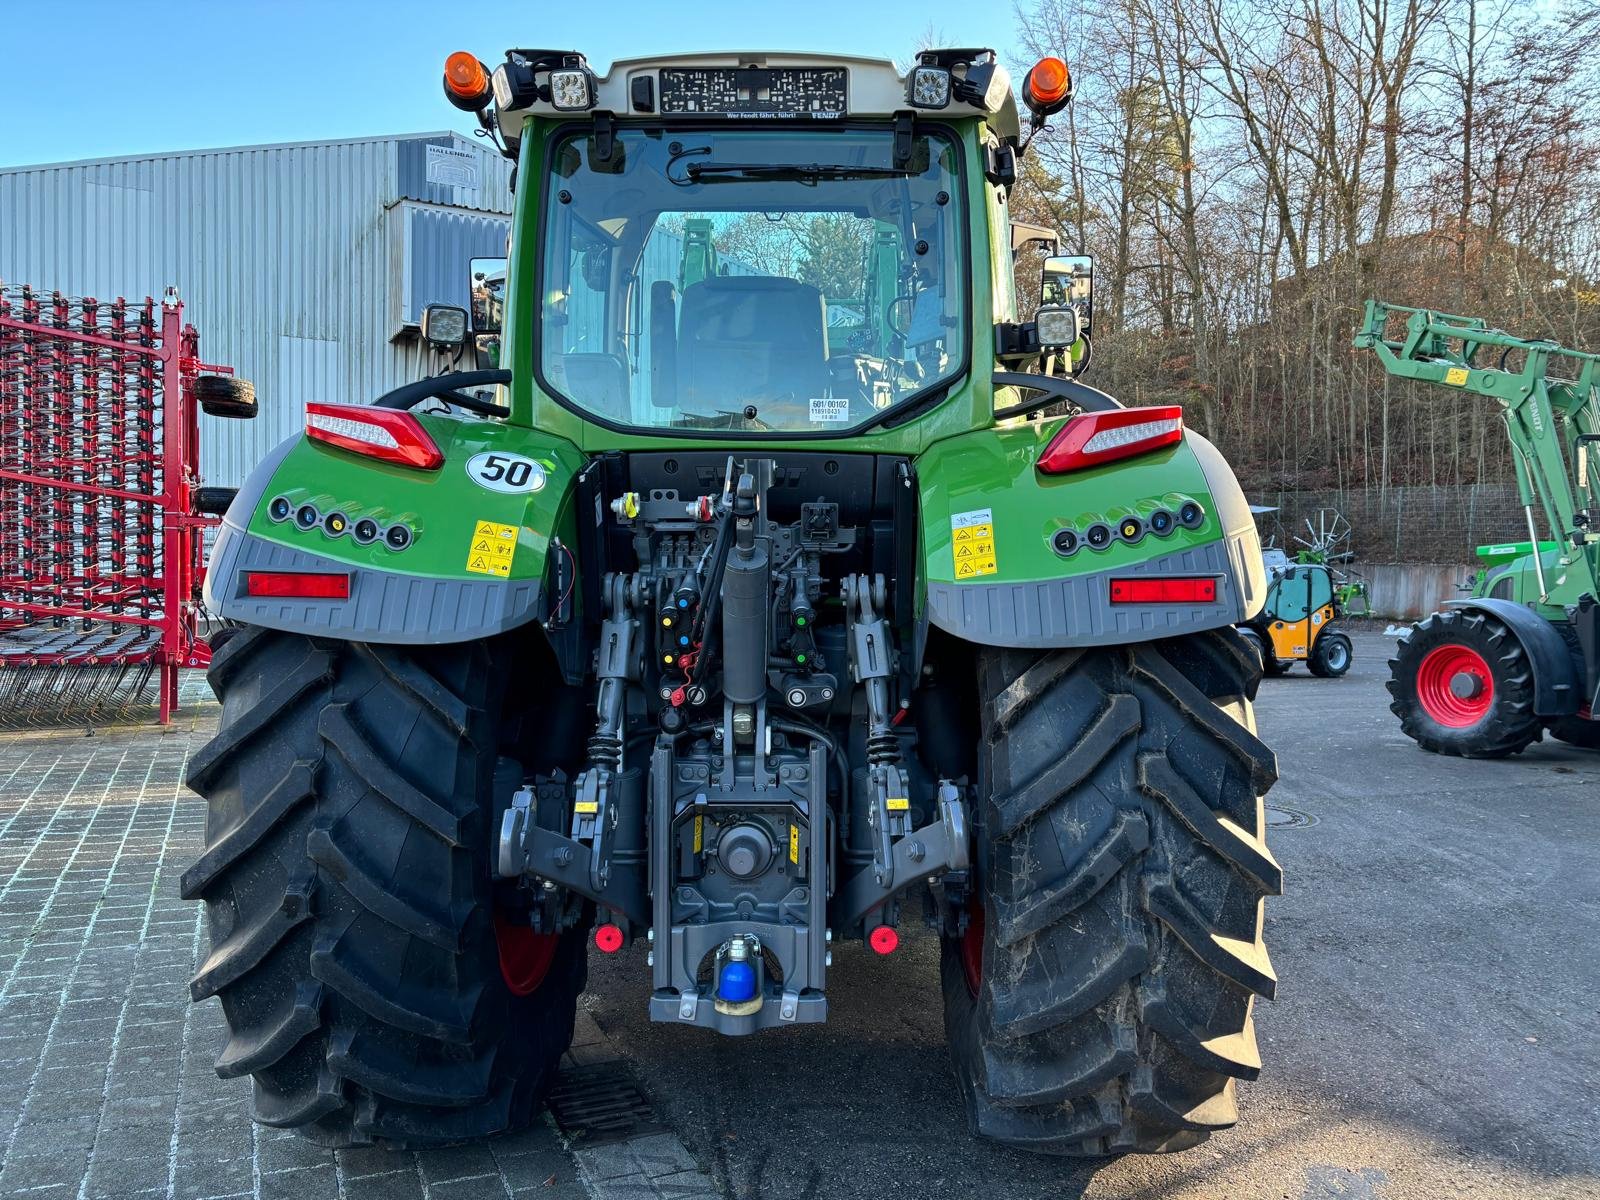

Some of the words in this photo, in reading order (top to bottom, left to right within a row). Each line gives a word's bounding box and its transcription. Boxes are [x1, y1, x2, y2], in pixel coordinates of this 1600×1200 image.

[1528, 395, 1544, 432] FENDT
[480, 455, 533, 487] 50
[695, 465, 808, 488] FET
